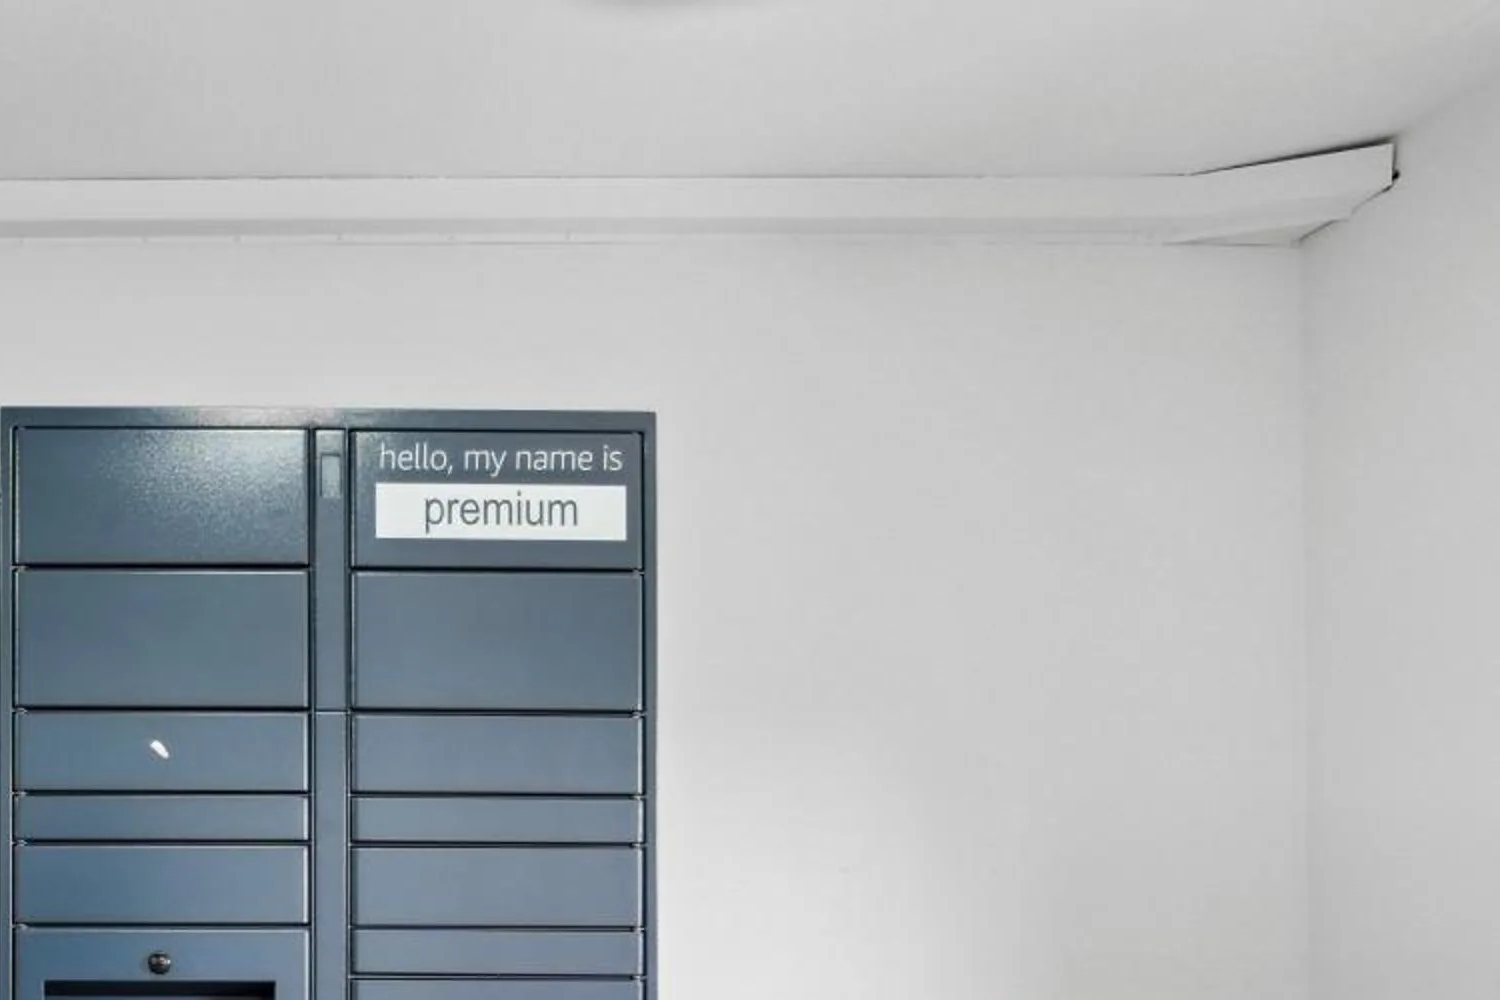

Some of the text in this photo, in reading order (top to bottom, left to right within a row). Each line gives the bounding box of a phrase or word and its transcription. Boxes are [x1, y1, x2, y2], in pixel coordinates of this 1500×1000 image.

[378, 442, 624, 477] hello, my name is
[424, 490, 578, 534] premium
